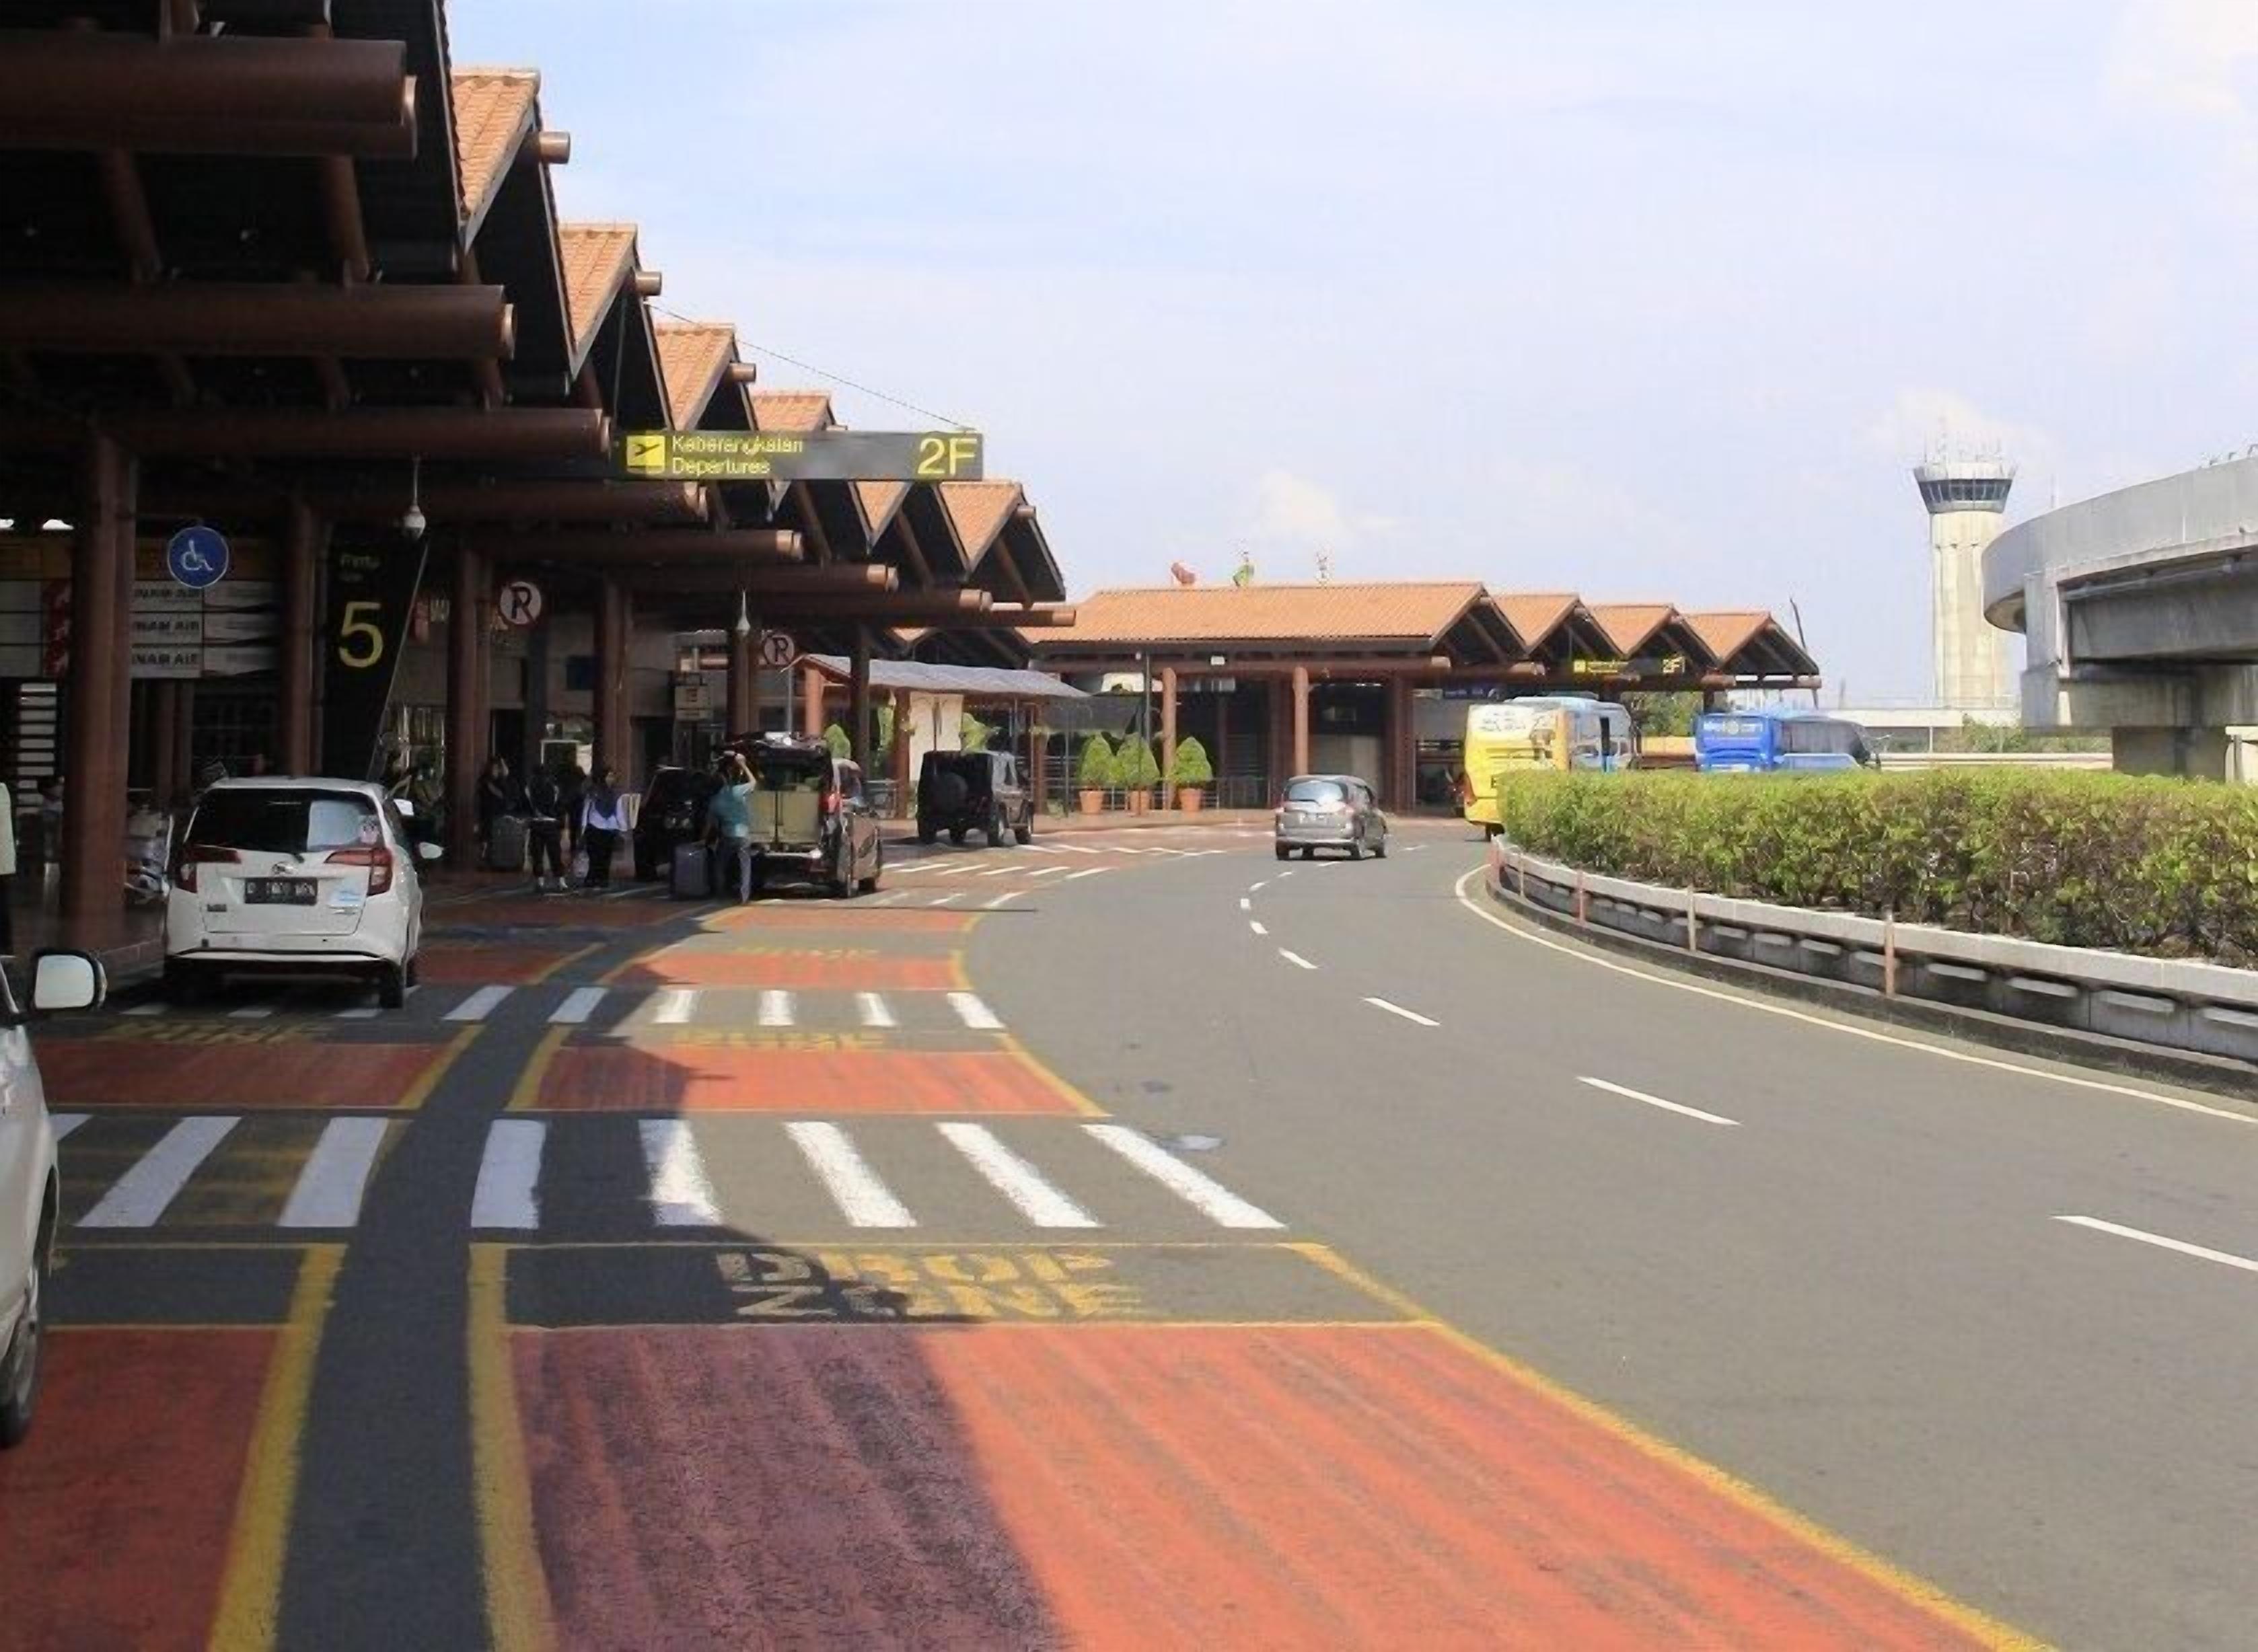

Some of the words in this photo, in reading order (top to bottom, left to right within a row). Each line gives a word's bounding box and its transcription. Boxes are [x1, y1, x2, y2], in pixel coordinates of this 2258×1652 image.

[673, 457, 770, 476] Departures
[916, 437, 977, 475] 2F
[339, 601, 384, 668] 5
